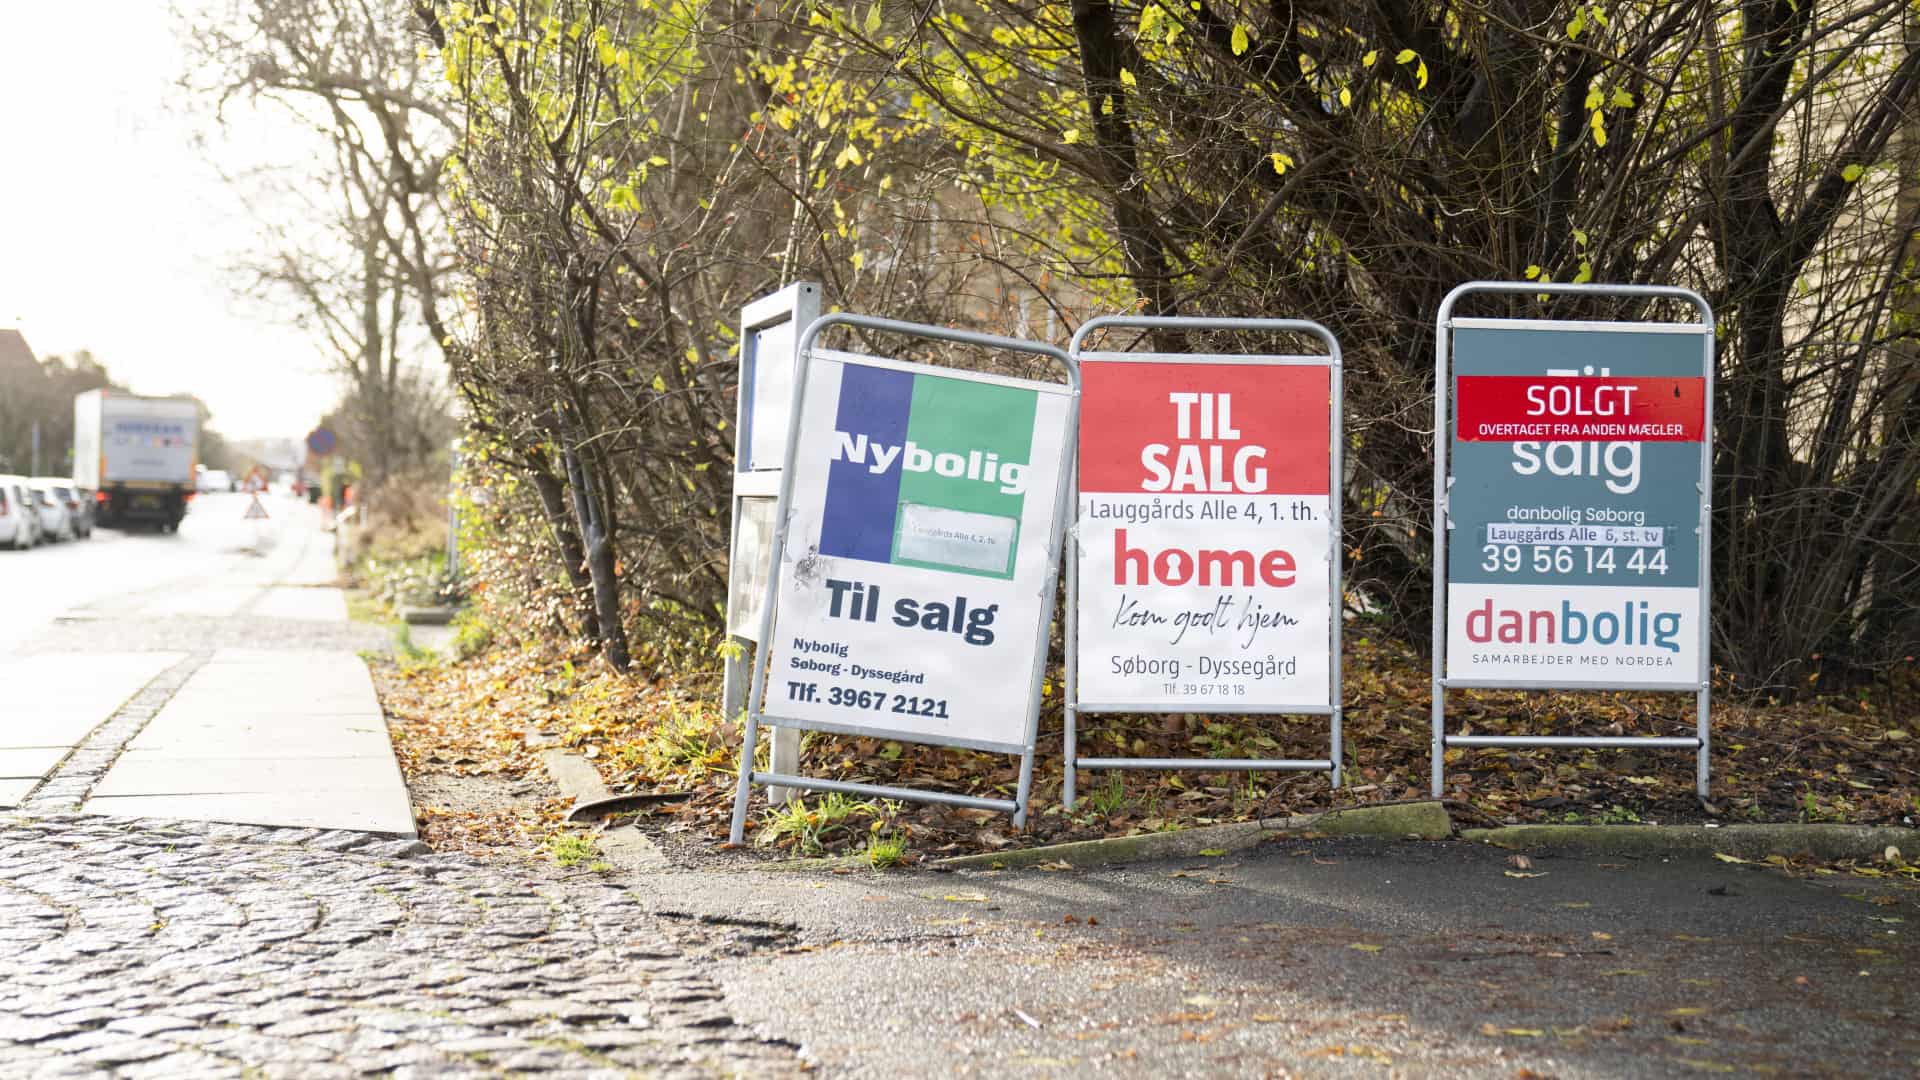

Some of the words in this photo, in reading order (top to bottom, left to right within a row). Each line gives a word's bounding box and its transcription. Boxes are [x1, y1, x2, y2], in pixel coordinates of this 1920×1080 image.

[1169, 392, 1241, 440] TIL
[1526, 384, 1639, 417] SOLGT
[1479, 423, 1552, 436] OVERTAGET
[1554, 424, 1580, 436] FRA
[1582, 424, 1626, 436] ANDEN
[1628, 424, 1683, 437] MÆGLER
[830, 430, 1031, 496] Nybolig
[1140, 443, 1268, 493] SALG
[1511, 440, 1642, 495] salg
[1090, 498, 1195, 524] Lauggårds
[1199, 499, 1238, 520] Alle
[1243, 501, 1263, 524] 4,
[1271, 502, 1284, 521] 1.
[1291, 500, 1318, 521] th.
[1506, 505, 1582, 525] danbolig
[1585, 507, 1645, 527] Søborg
[1490, 526, 1565, 543] Lauggårds
[1568, 527, 1597, 542] Alle
[1605, 528, 1617, 544] 6,
[1622, 529, 1640, 542] st.
[1644, 530, 1658, 542] tv
[1114, 528, 1297, 588] home
[1481, 544, 1522, 573] 39
[1533, 545, 1574, 574] 56
[1584, 546, 1617, 575] 14
[1626, 547, 1669, 575] 44
[826, 578, 881, 623] Til
[891, 596, 999, 646] salg
[1112, 593, 1168, 629] Kom
[1169, 594, 1235, 646] godt
[1237, 595, 1299, 650] hjem
[1465, 598, 1682, 653] danbolig
[793, 637, 849, 658] Nybolig
[1472, 654, 1574, 666] SAMARBEJDER
[1580, 655, 1609, 666] MED
[1615, 656, 1673, 667] NORDEA
[790, 656, 841, 676] Søborg
[850, 663, 924, 684] Dyssegård
[1111, 655, 1180, 680] Søborg
[1199, 655, 1297, 681] Dyssegård
[787, 680, 821, 704] Tlf.
[827, 685, 887, 711] 3967
[891, 694, 949, 719] 2121
[1183, 684, 1197, 696] 39
[1200, 684, 1213, 696] 67
[1218, 684, 1230, 696] 18
[1234, 684, 1246, 696] 18
